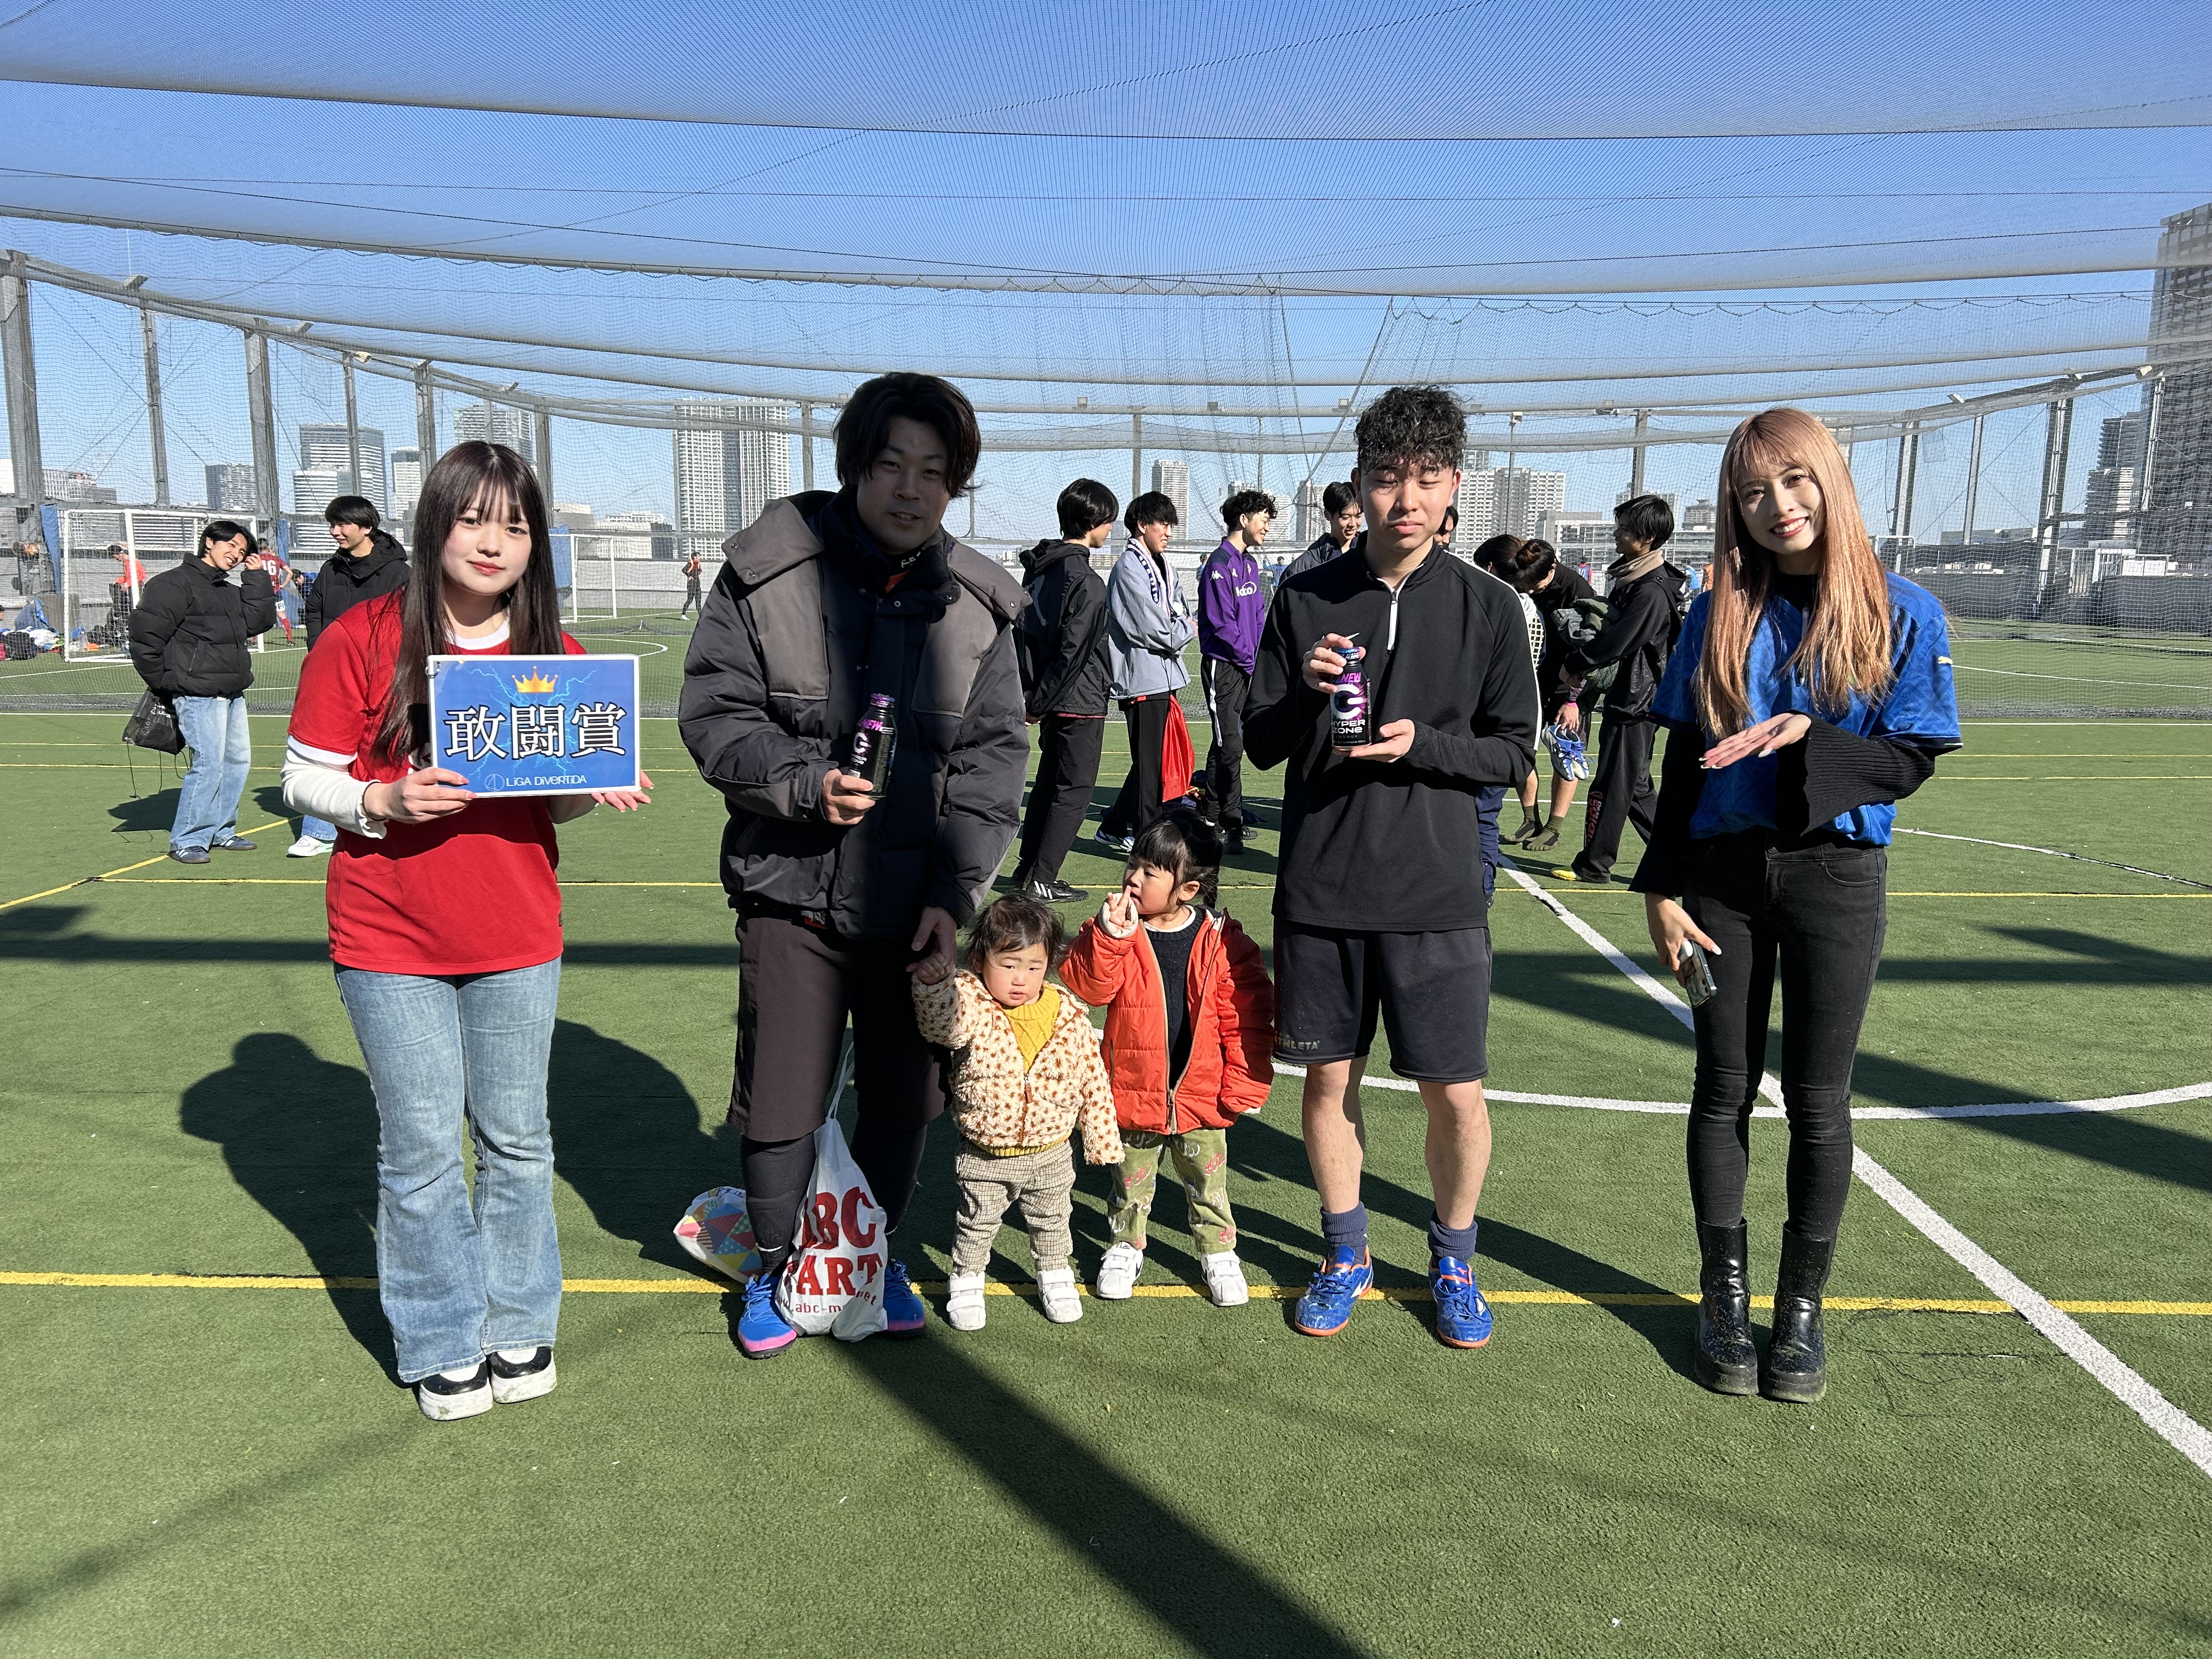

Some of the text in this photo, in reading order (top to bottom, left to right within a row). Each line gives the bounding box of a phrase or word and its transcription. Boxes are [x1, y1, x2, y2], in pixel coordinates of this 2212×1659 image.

[1340, 672, 1362, 683] NEW
[444, 701, 627, 761] 敢闘賞
[861, 719, 884, 731] NEW
